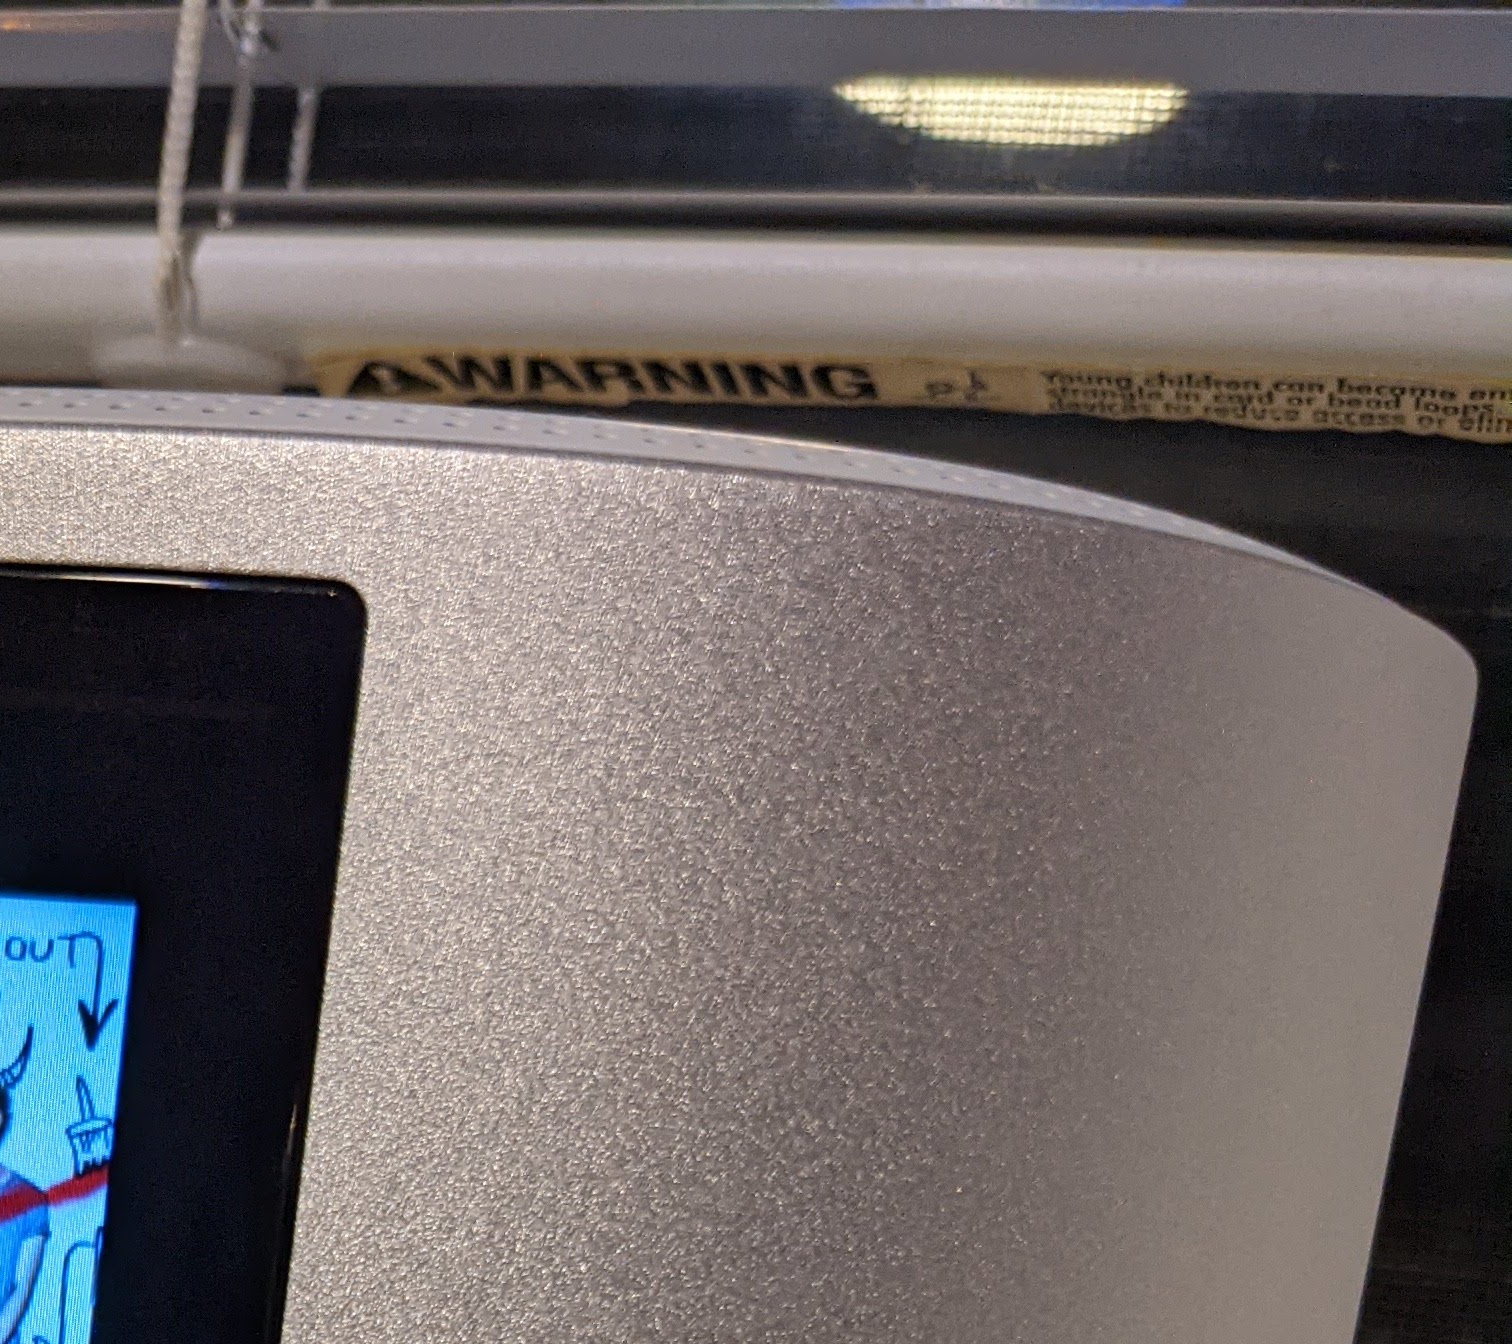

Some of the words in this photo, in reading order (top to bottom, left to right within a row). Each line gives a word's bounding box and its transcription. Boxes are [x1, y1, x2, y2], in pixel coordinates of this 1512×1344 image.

[424, 354, 879, 400] WARNING
[1144, 371, 1261, 390] children
[1273, 381, 1325, 394] can
[1337, 378, 1457, 401] become
[1287, 396, 1315, 407] or
[1327, 392, 1402, 409] bead
[1203, 404, 1300, 421] reduce
[1417, 414, 1446, 430] or
